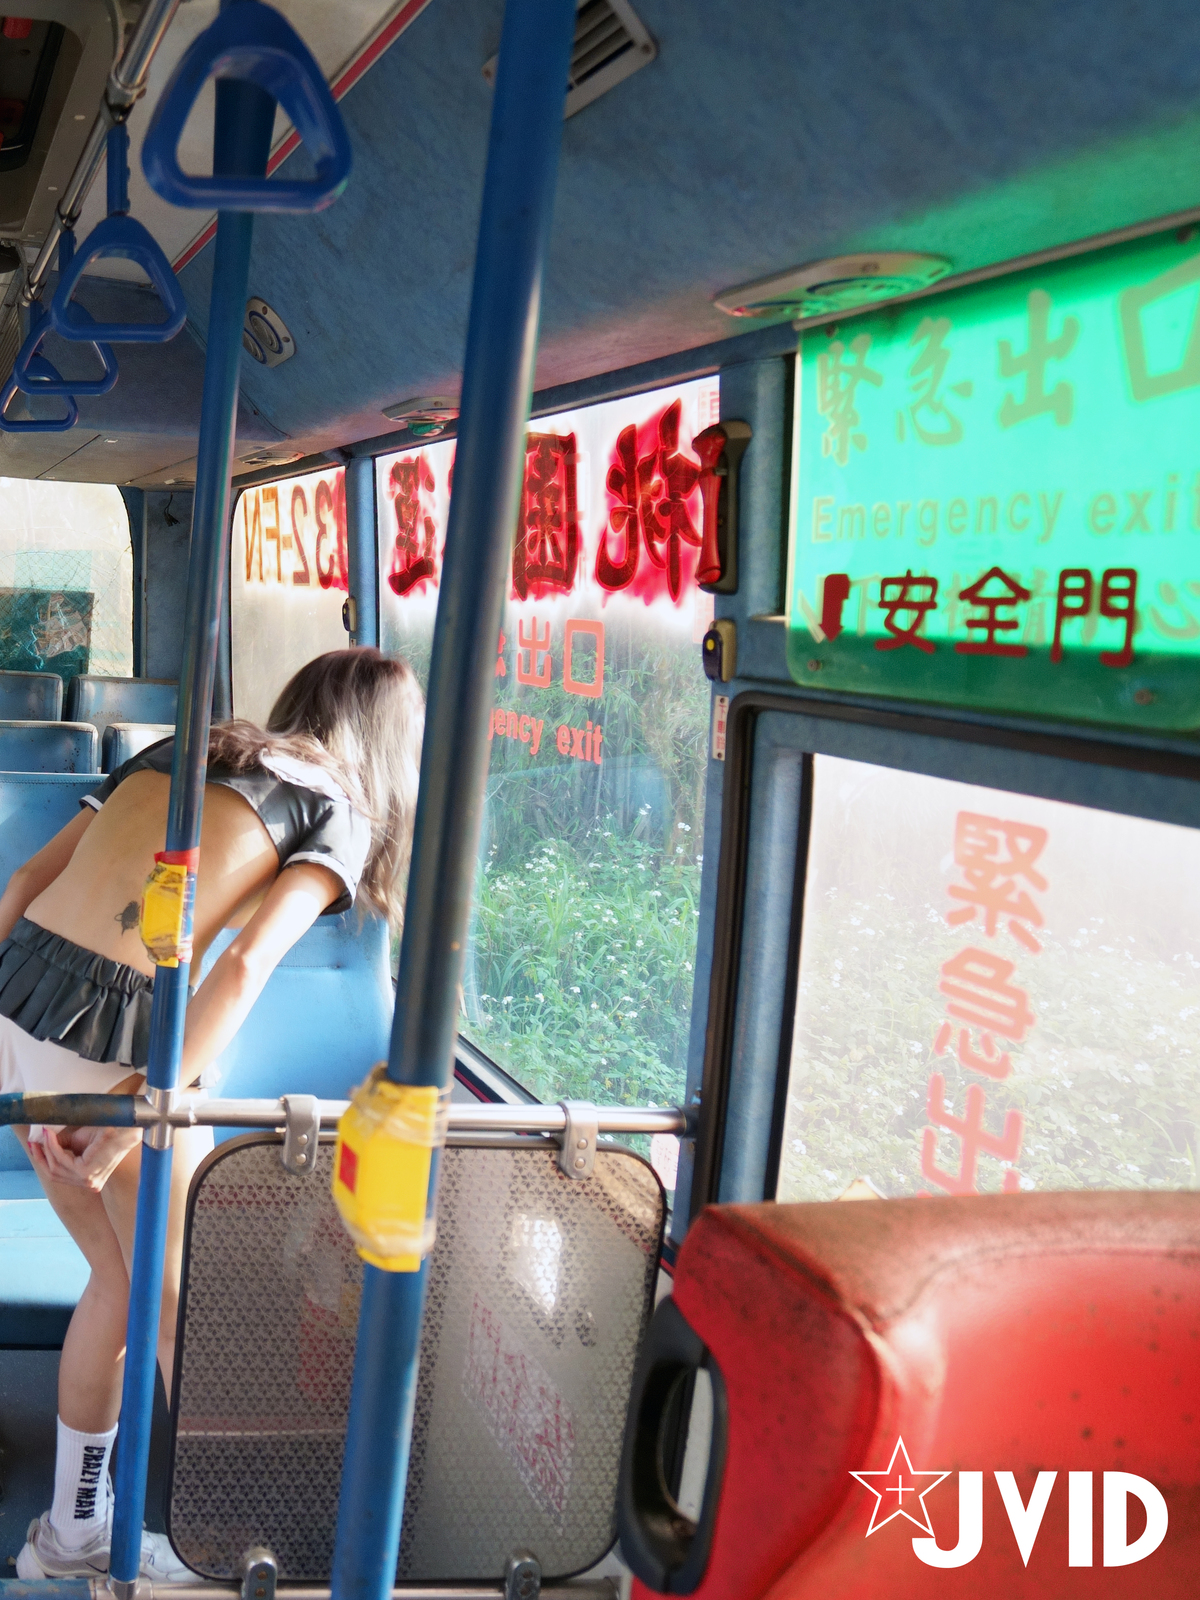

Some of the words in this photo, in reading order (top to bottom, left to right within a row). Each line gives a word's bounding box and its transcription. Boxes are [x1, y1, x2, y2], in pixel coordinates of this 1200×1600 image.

[816, 256, 1200, 466] 緊急出口
[811, 489, 1066, 548] Emergency
[874, 566, 1140, 669] 安全門
[556, 720, 603, 766] exit
[79, 1445, 107, 1484] CRAZY
[74, 1487, 98, 1520] MAN
